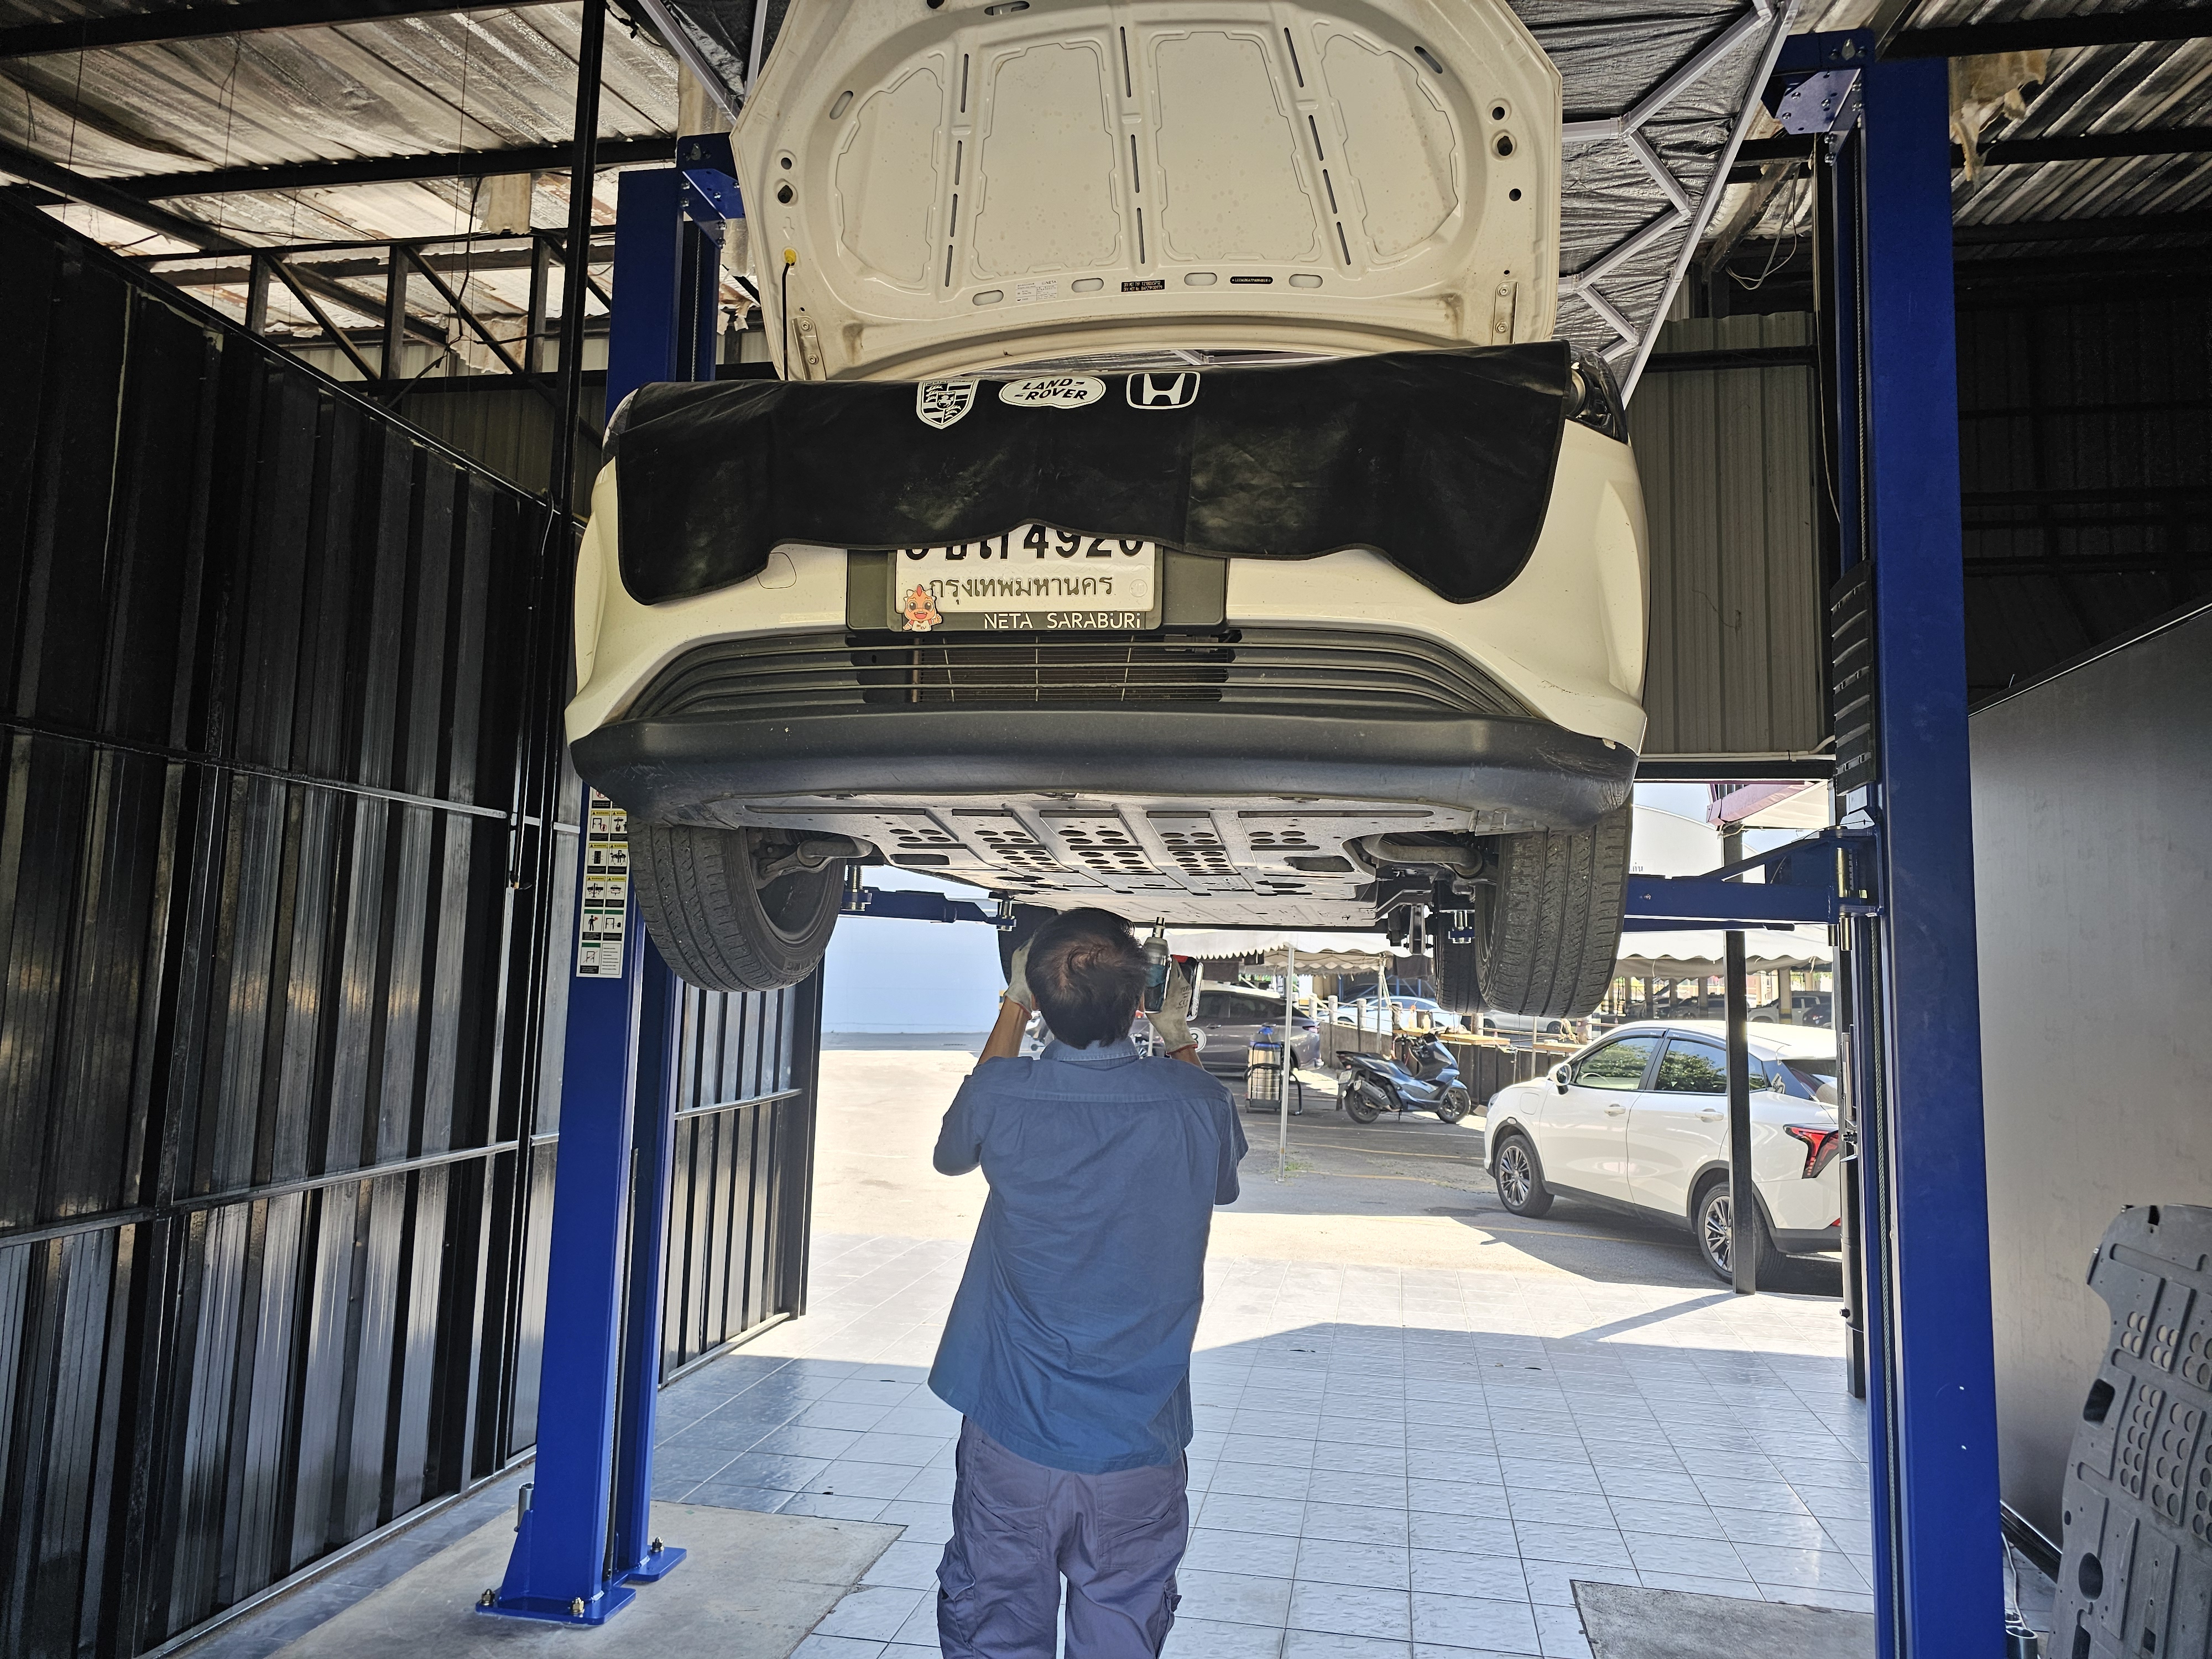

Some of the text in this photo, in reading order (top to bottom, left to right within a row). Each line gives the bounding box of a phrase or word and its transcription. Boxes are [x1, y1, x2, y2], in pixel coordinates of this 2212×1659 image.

[929, 576, 1113, 605] กรุงเทพมหานคร
[984, 613, 1034, 629] NETA
